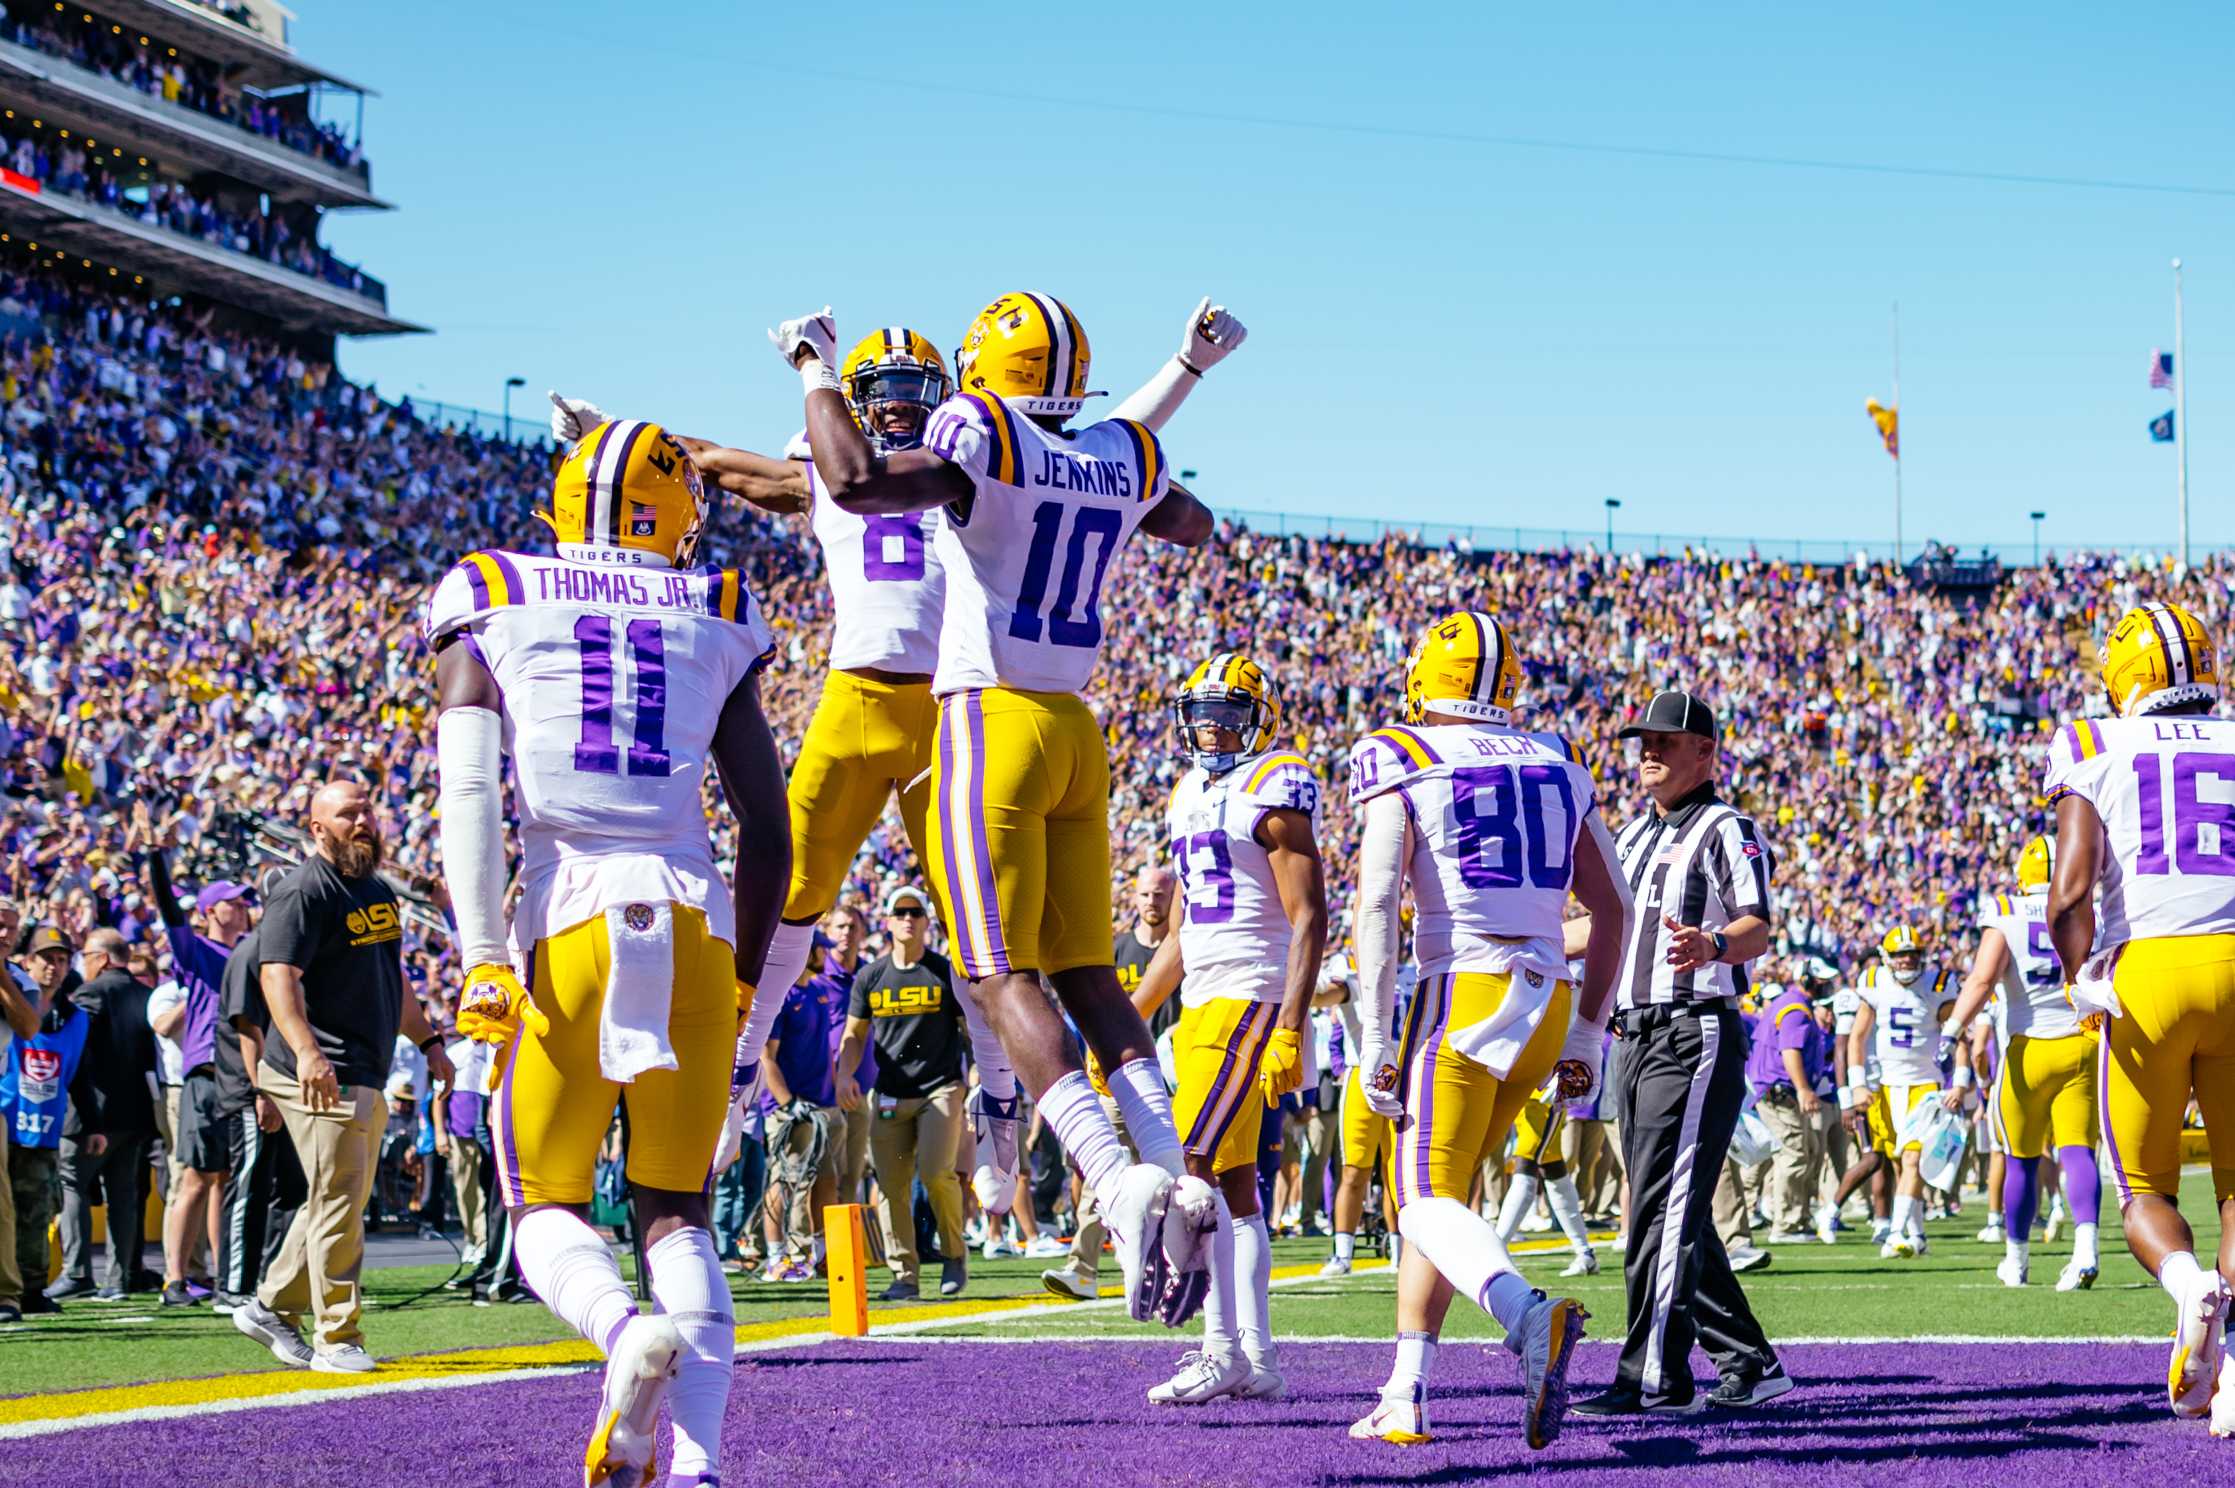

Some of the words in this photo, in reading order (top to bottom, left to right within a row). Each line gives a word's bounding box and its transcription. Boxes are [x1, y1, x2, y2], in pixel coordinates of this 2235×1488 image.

[1027, 400, 1081, 411] TIGERS
[929, 411, 967, 461] 10
[1035, 450, 1131, 497] JENKINS
[570, 549, 642, 564] TIGERS
[863, 512, 924, 581] 8
[533, 567, 648, 606] THOMAS
[657, 576, 700, 609] JR.
[1008, 501, 1122, 648] 10
[574, 615, 670, 776] 11
[1453, 704, 1504, 719] TIGERS
[1469, 736, 1537, 756] BECK
[2154, 723, 2211, 740] LEE
[1452, 764, 1576, 890] 80
[2133, 752, 2235, 877] 16
[882, 986, 942, 1008] LSU
[1890, 1008, 1913, 1048] 5
[16, 1111, 55, 1134] 317
